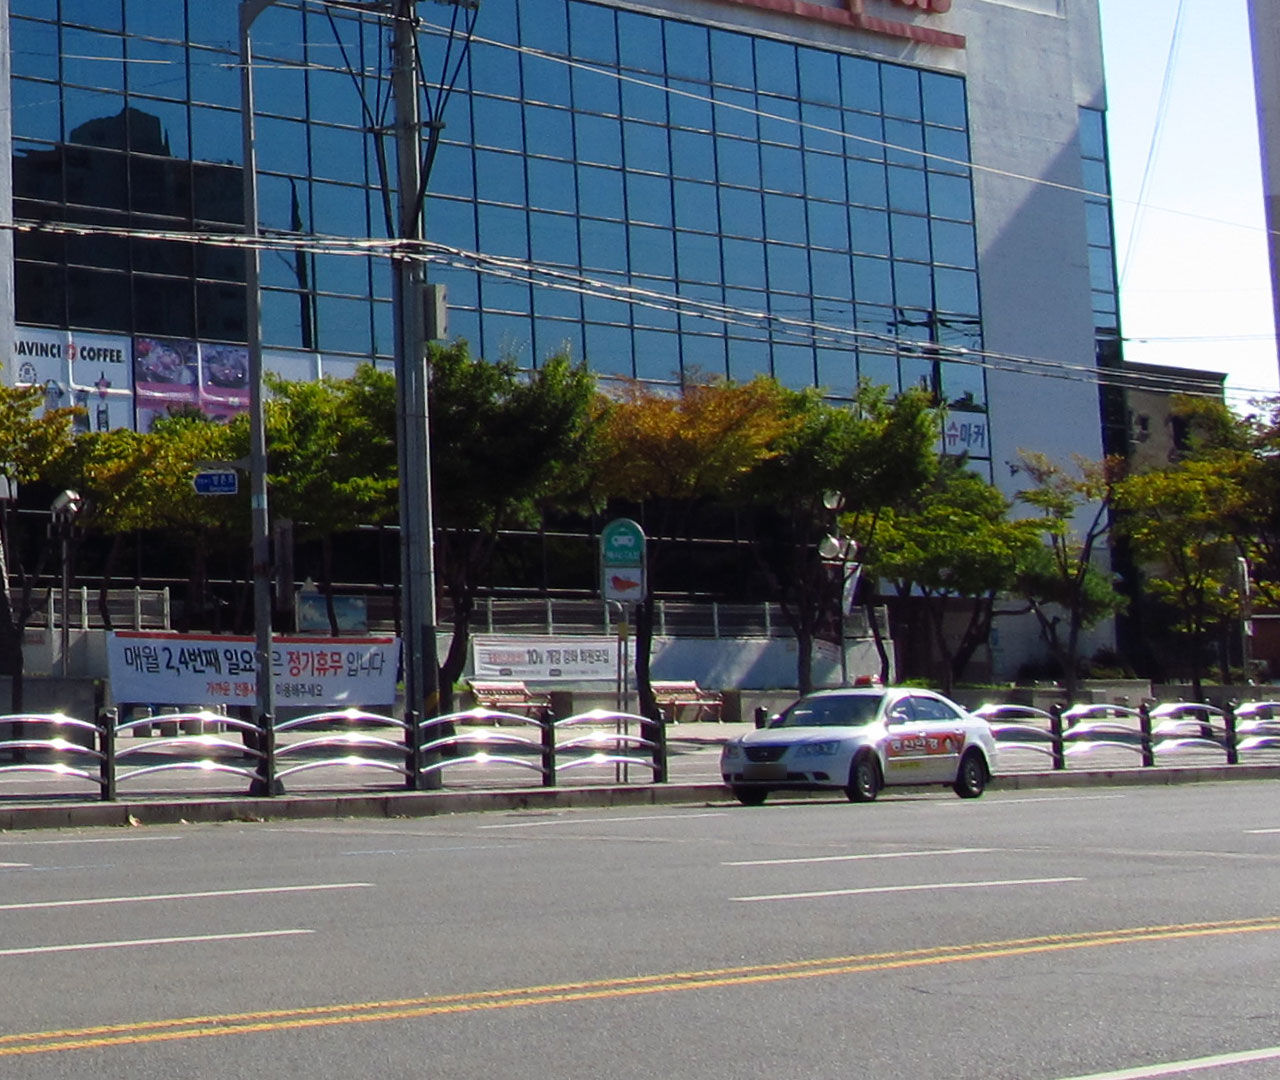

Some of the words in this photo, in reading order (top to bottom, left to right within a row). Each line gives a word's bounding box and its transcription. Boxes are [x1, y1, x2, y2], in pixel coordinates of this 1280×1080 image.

[80, 346, 123, 363] COFFEE
[946, 421, 985, 448] 슈마커
[124, 646, 160, 673] 매월
[162, 647, 222, 676] 2,4번째
[224, 649, 283, 676] 일요은
[286, 651, 344, 678] 정기휴무
[346, 652, 386, 678] 입니다
